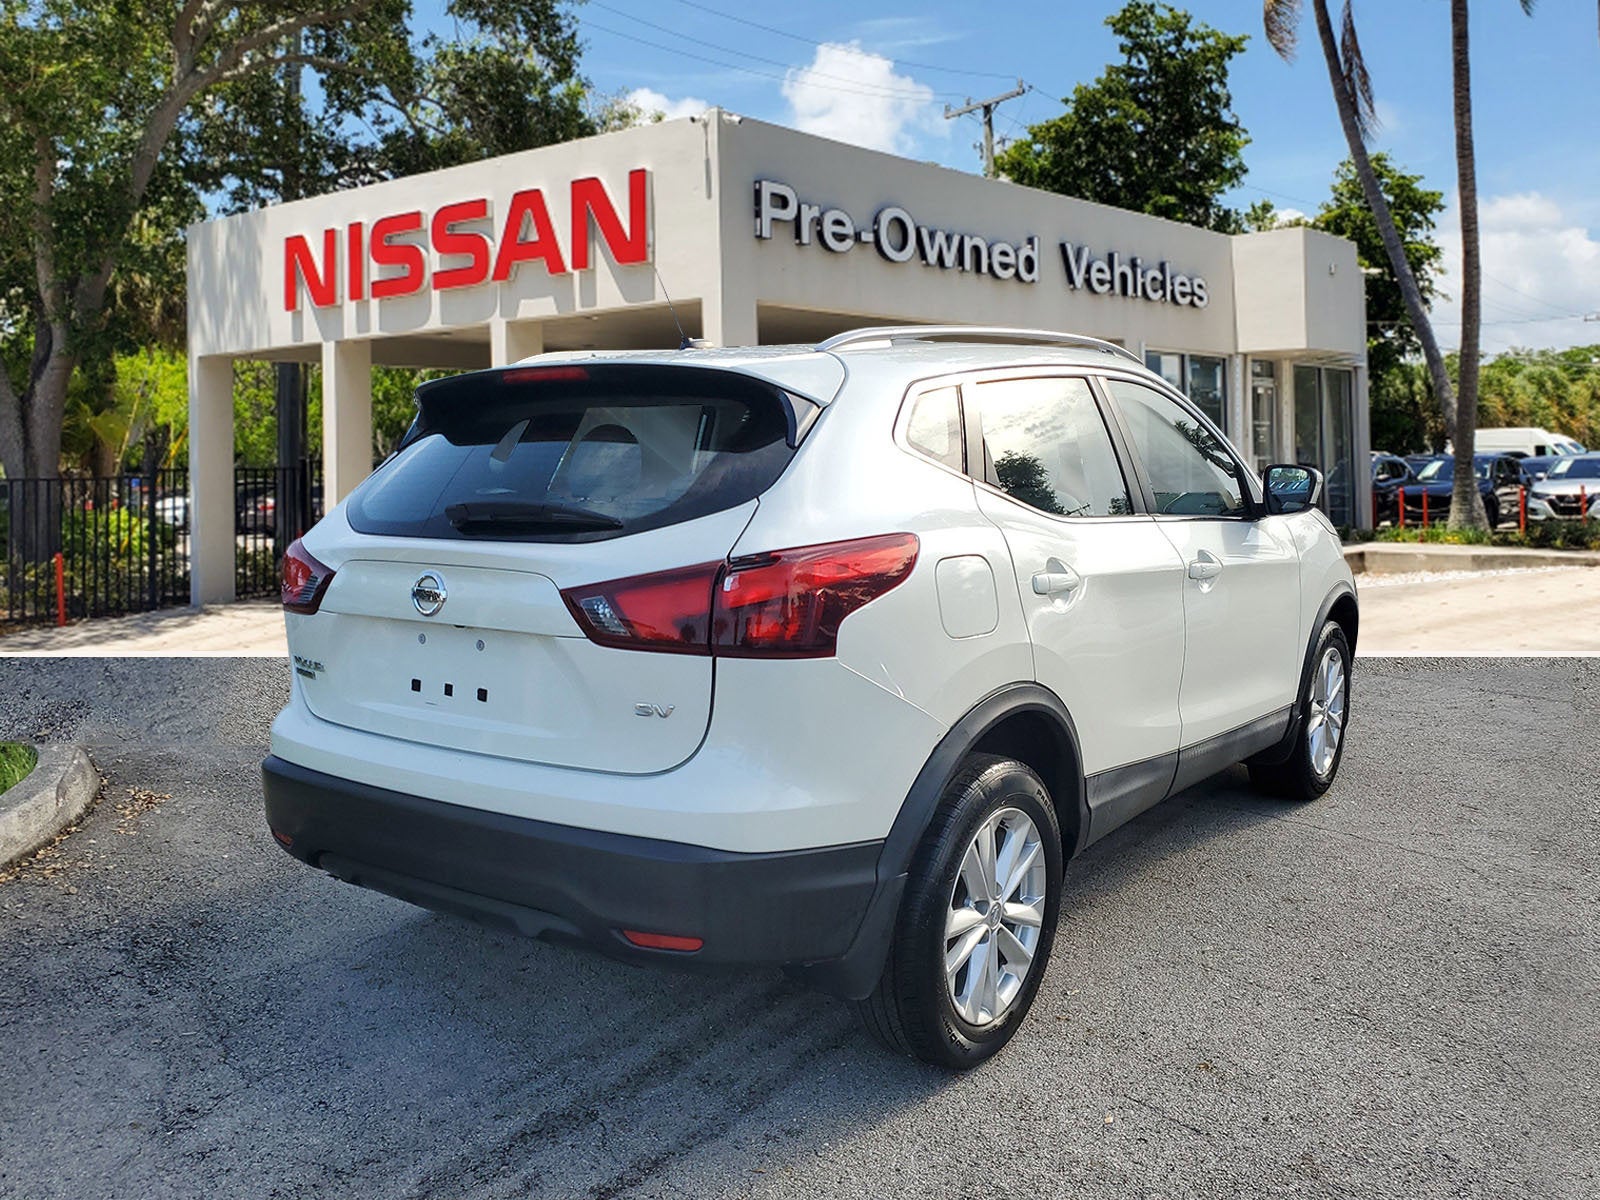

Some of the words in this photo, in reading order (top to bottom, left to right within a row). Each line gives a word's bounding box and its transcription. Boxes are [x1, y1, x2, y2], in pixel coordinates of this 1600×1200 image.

[285, 168, 648, 312] NISSAN
[755, 179, 1040, 284] Pre-Owned
[1060, 241, 1209, 309] Vehicles
[635, 703, 676, 719] SV
